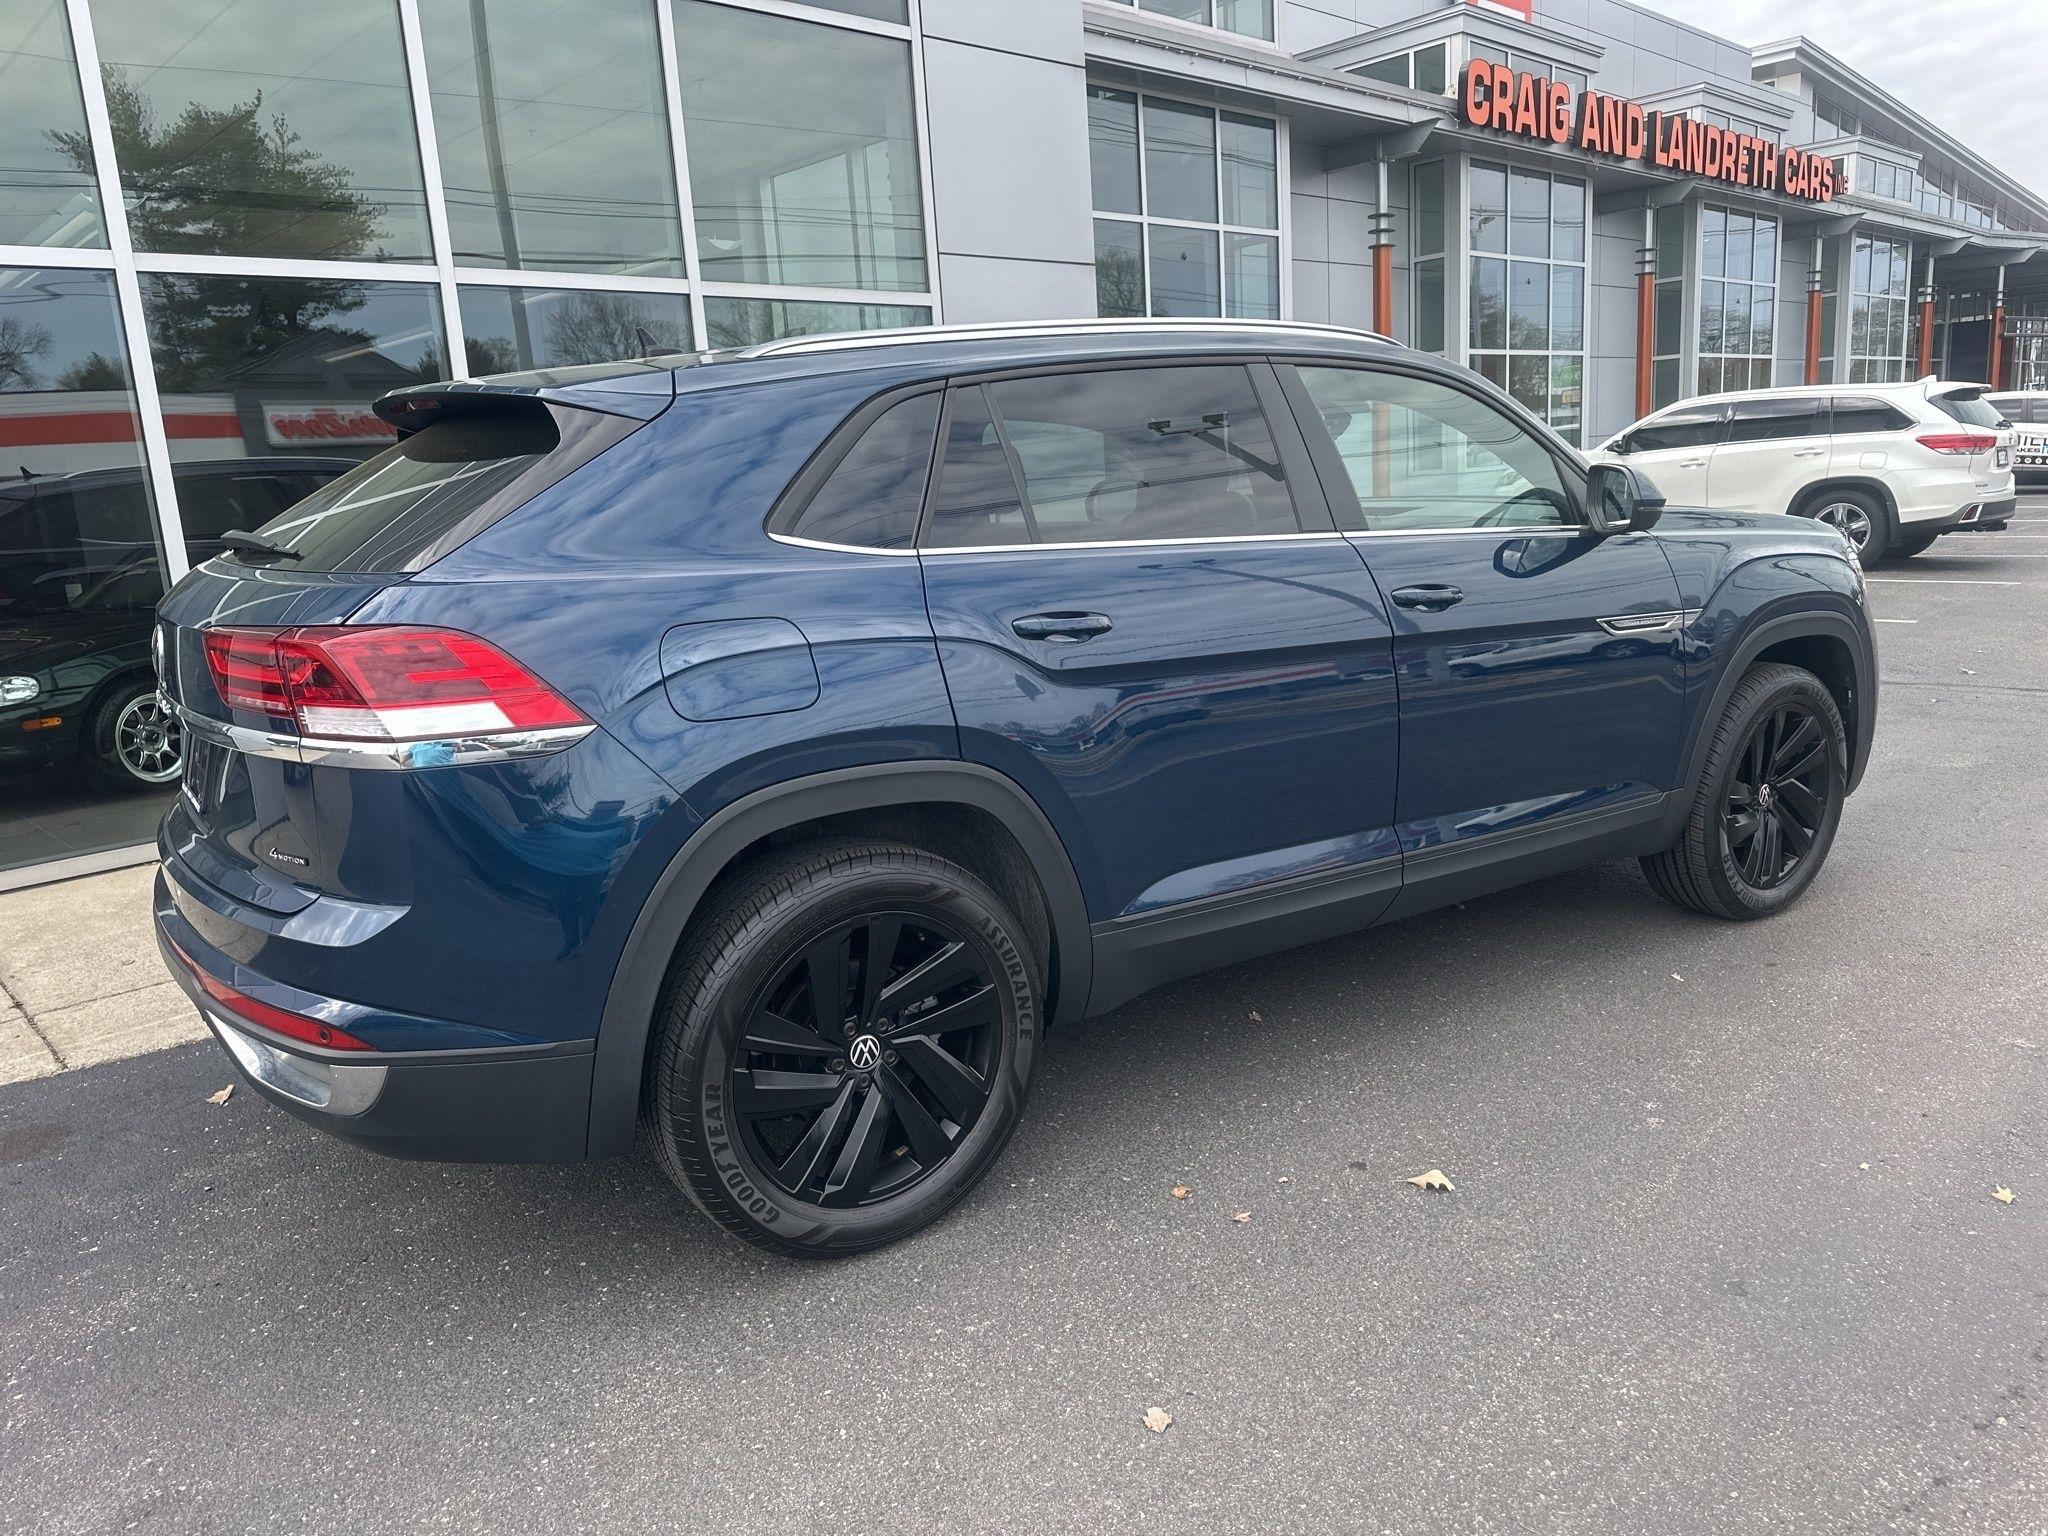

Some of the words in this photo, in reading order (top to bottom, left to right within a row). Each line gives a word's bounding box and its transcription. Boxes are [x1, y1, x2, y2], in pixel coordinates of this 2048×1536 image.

[1465, 58, 1571, 144] CRAIG
[1580, 91, 1644, 160] AND
[1654, 110, 1779, 190] LANDRETH
[1783, 147, 1833, 202] CARS
[269, 847, 307, 866] 4MOTION
[974, 916, 1034, 1041] ASSURANCE
[704, 1081, 781, 1224] GOODYEAR
